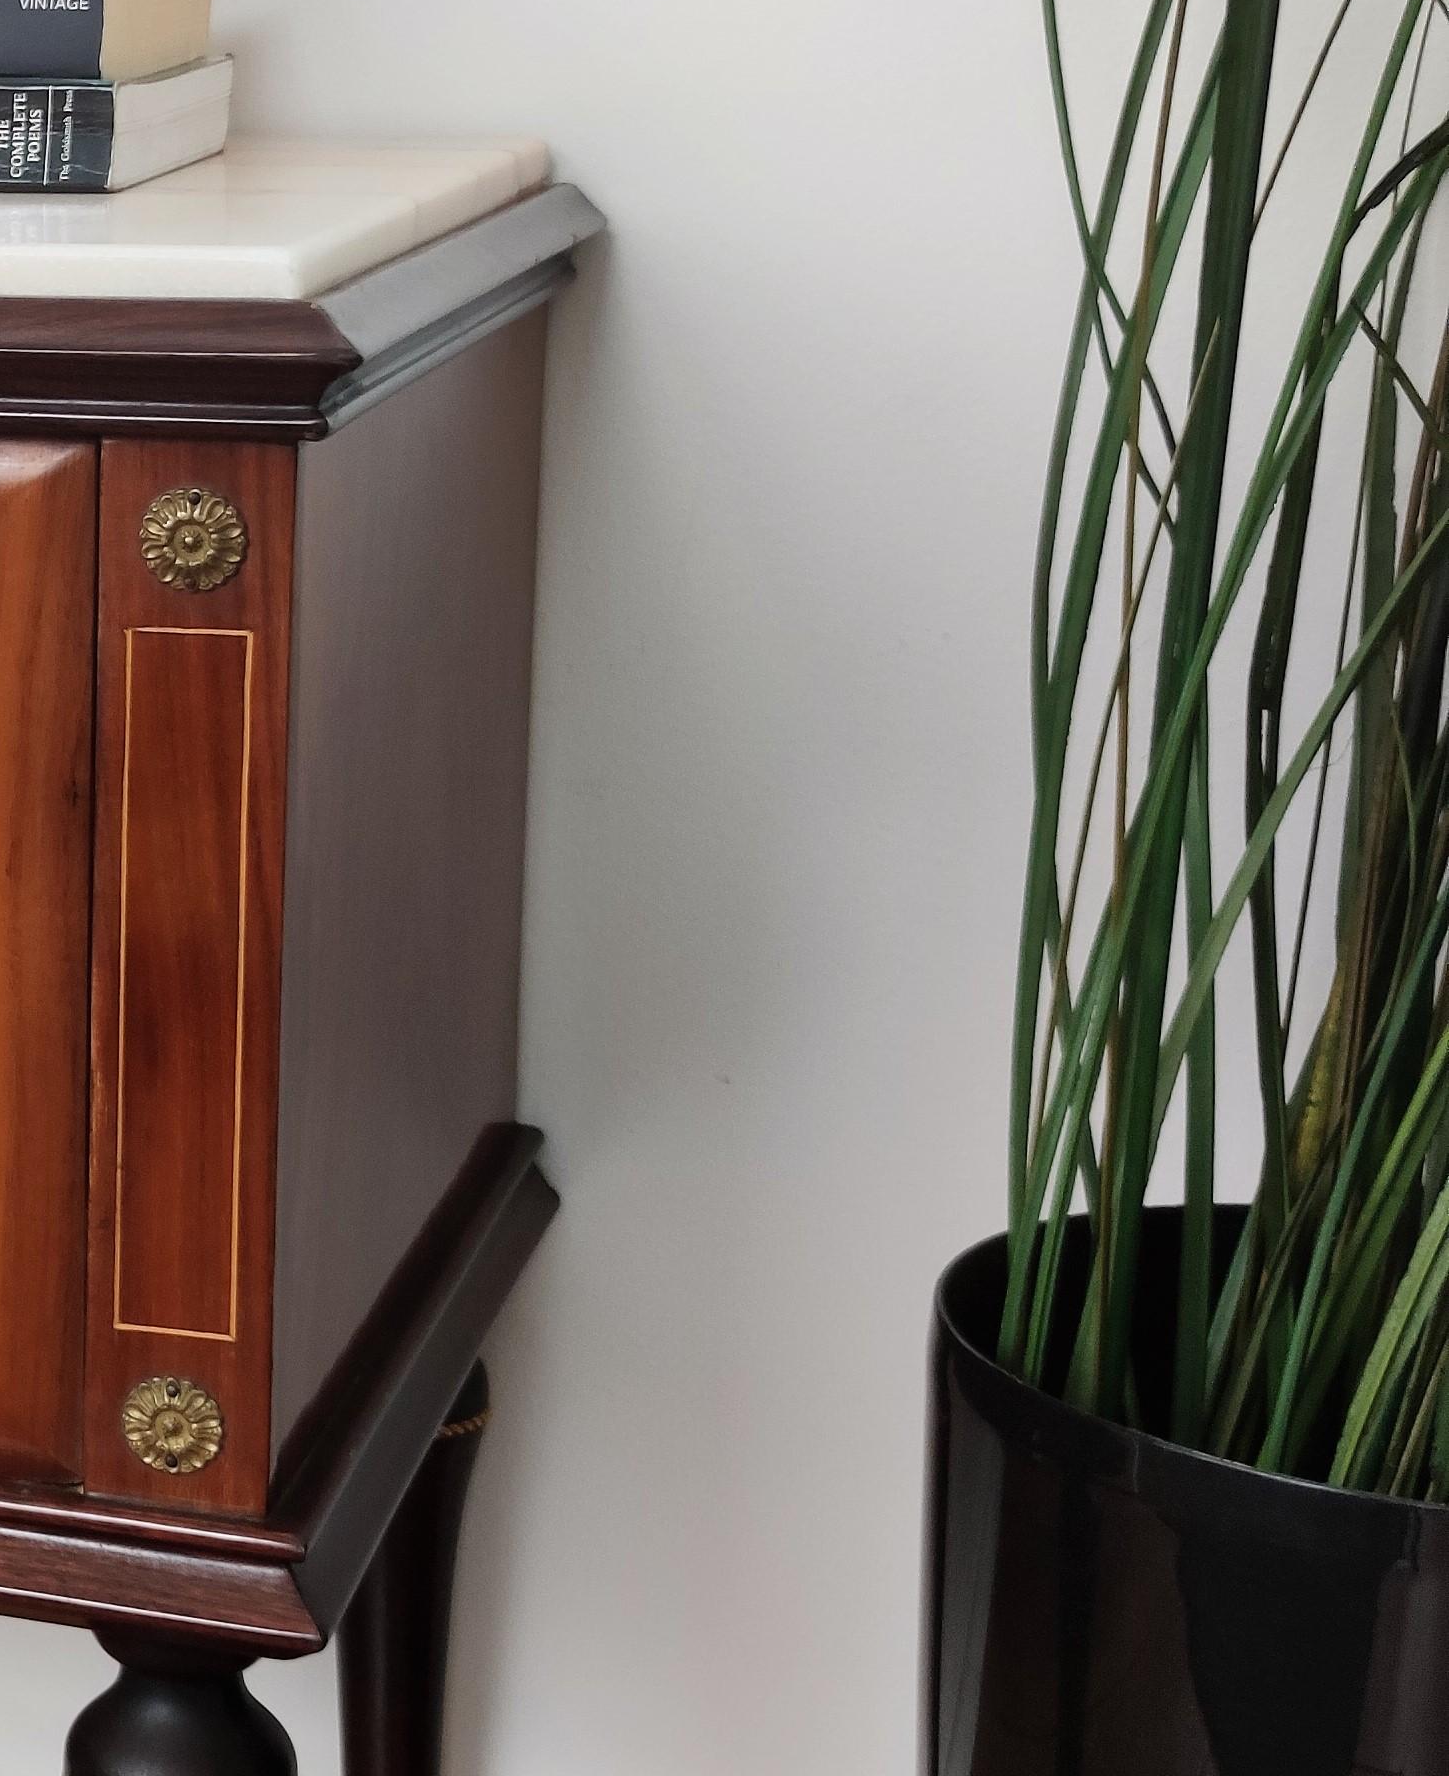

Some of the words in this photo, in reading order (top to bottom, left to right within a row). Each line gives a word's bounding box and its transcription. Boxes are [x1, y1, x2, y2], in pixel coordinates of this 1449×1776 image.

[63, 90, 73, 112] Press
[10, 92, 28, 178] COMPLETE
[27, 109, 43, 162] POEMS
